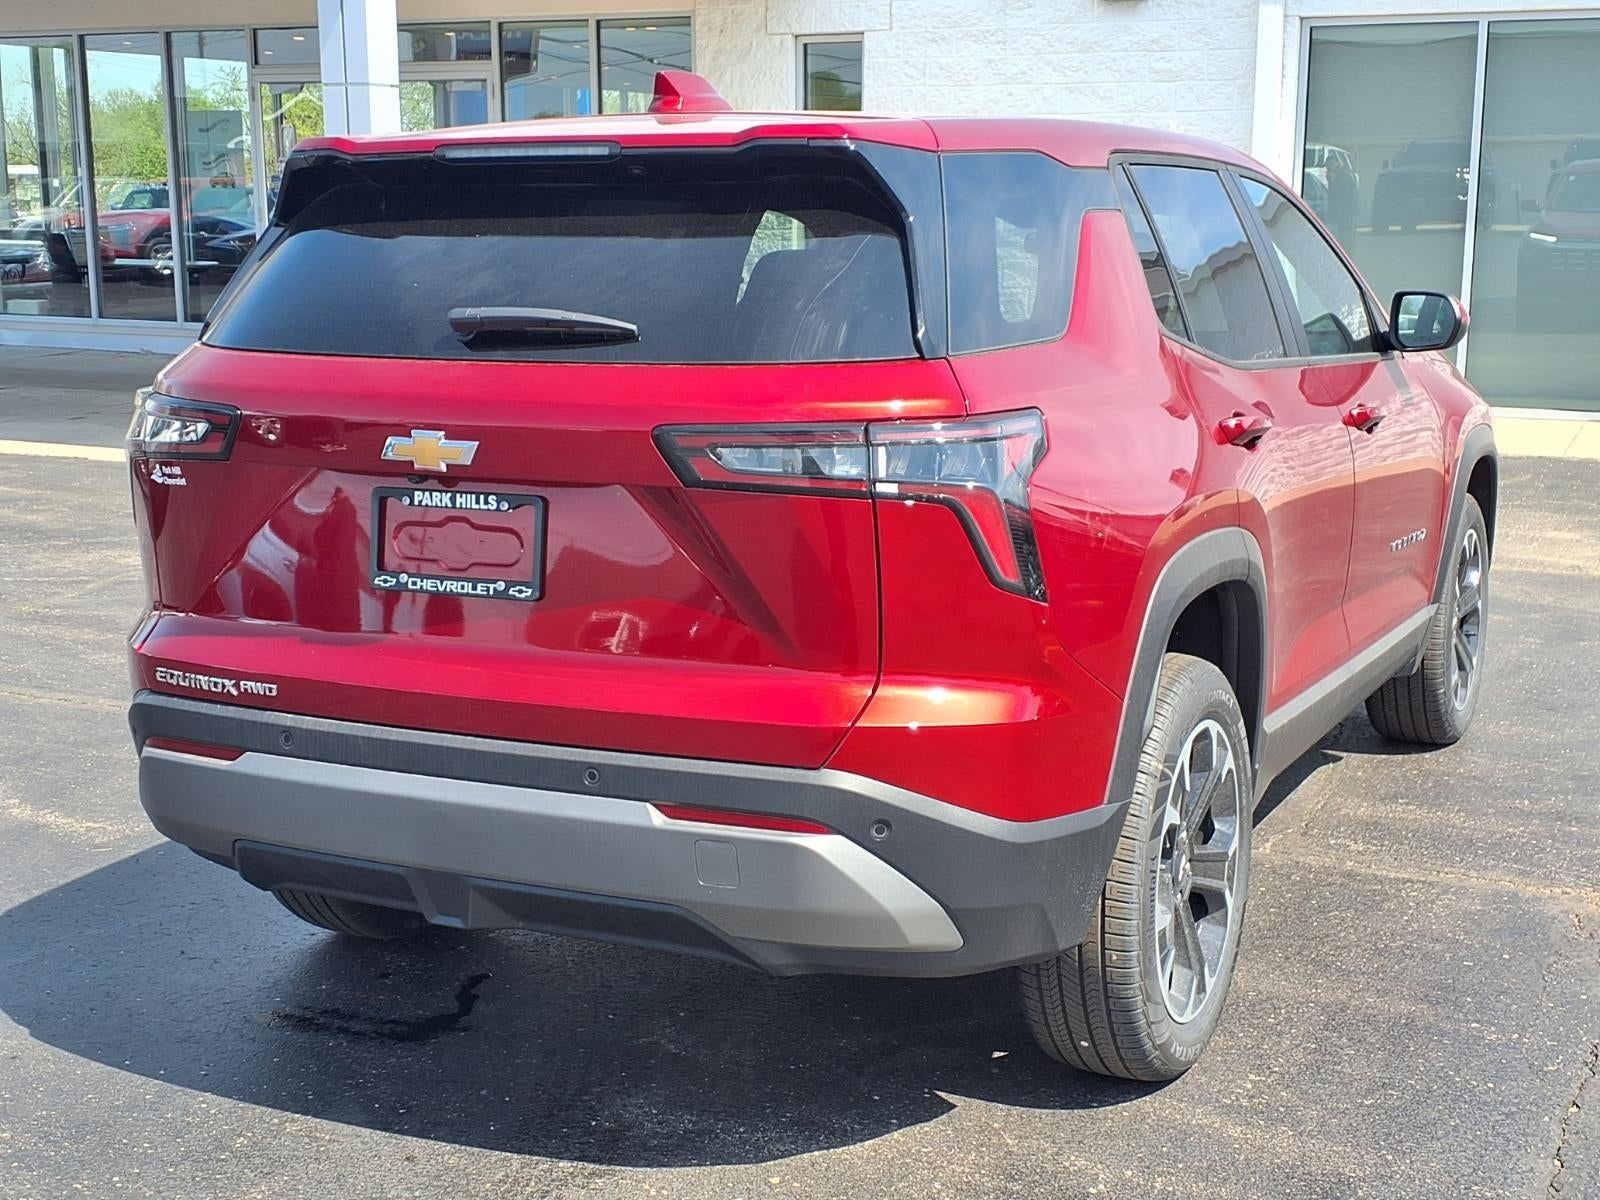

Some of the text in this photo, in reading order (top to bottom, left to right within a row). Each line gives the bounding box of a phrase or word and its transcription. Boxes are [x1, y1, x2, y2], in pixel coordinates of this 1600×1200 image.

[413, 490, 498, 510] PARK HILLS
[407, 577, 497, 596] CHEVROLET
[154, 666, 278, 697] EQUINOX AWD
